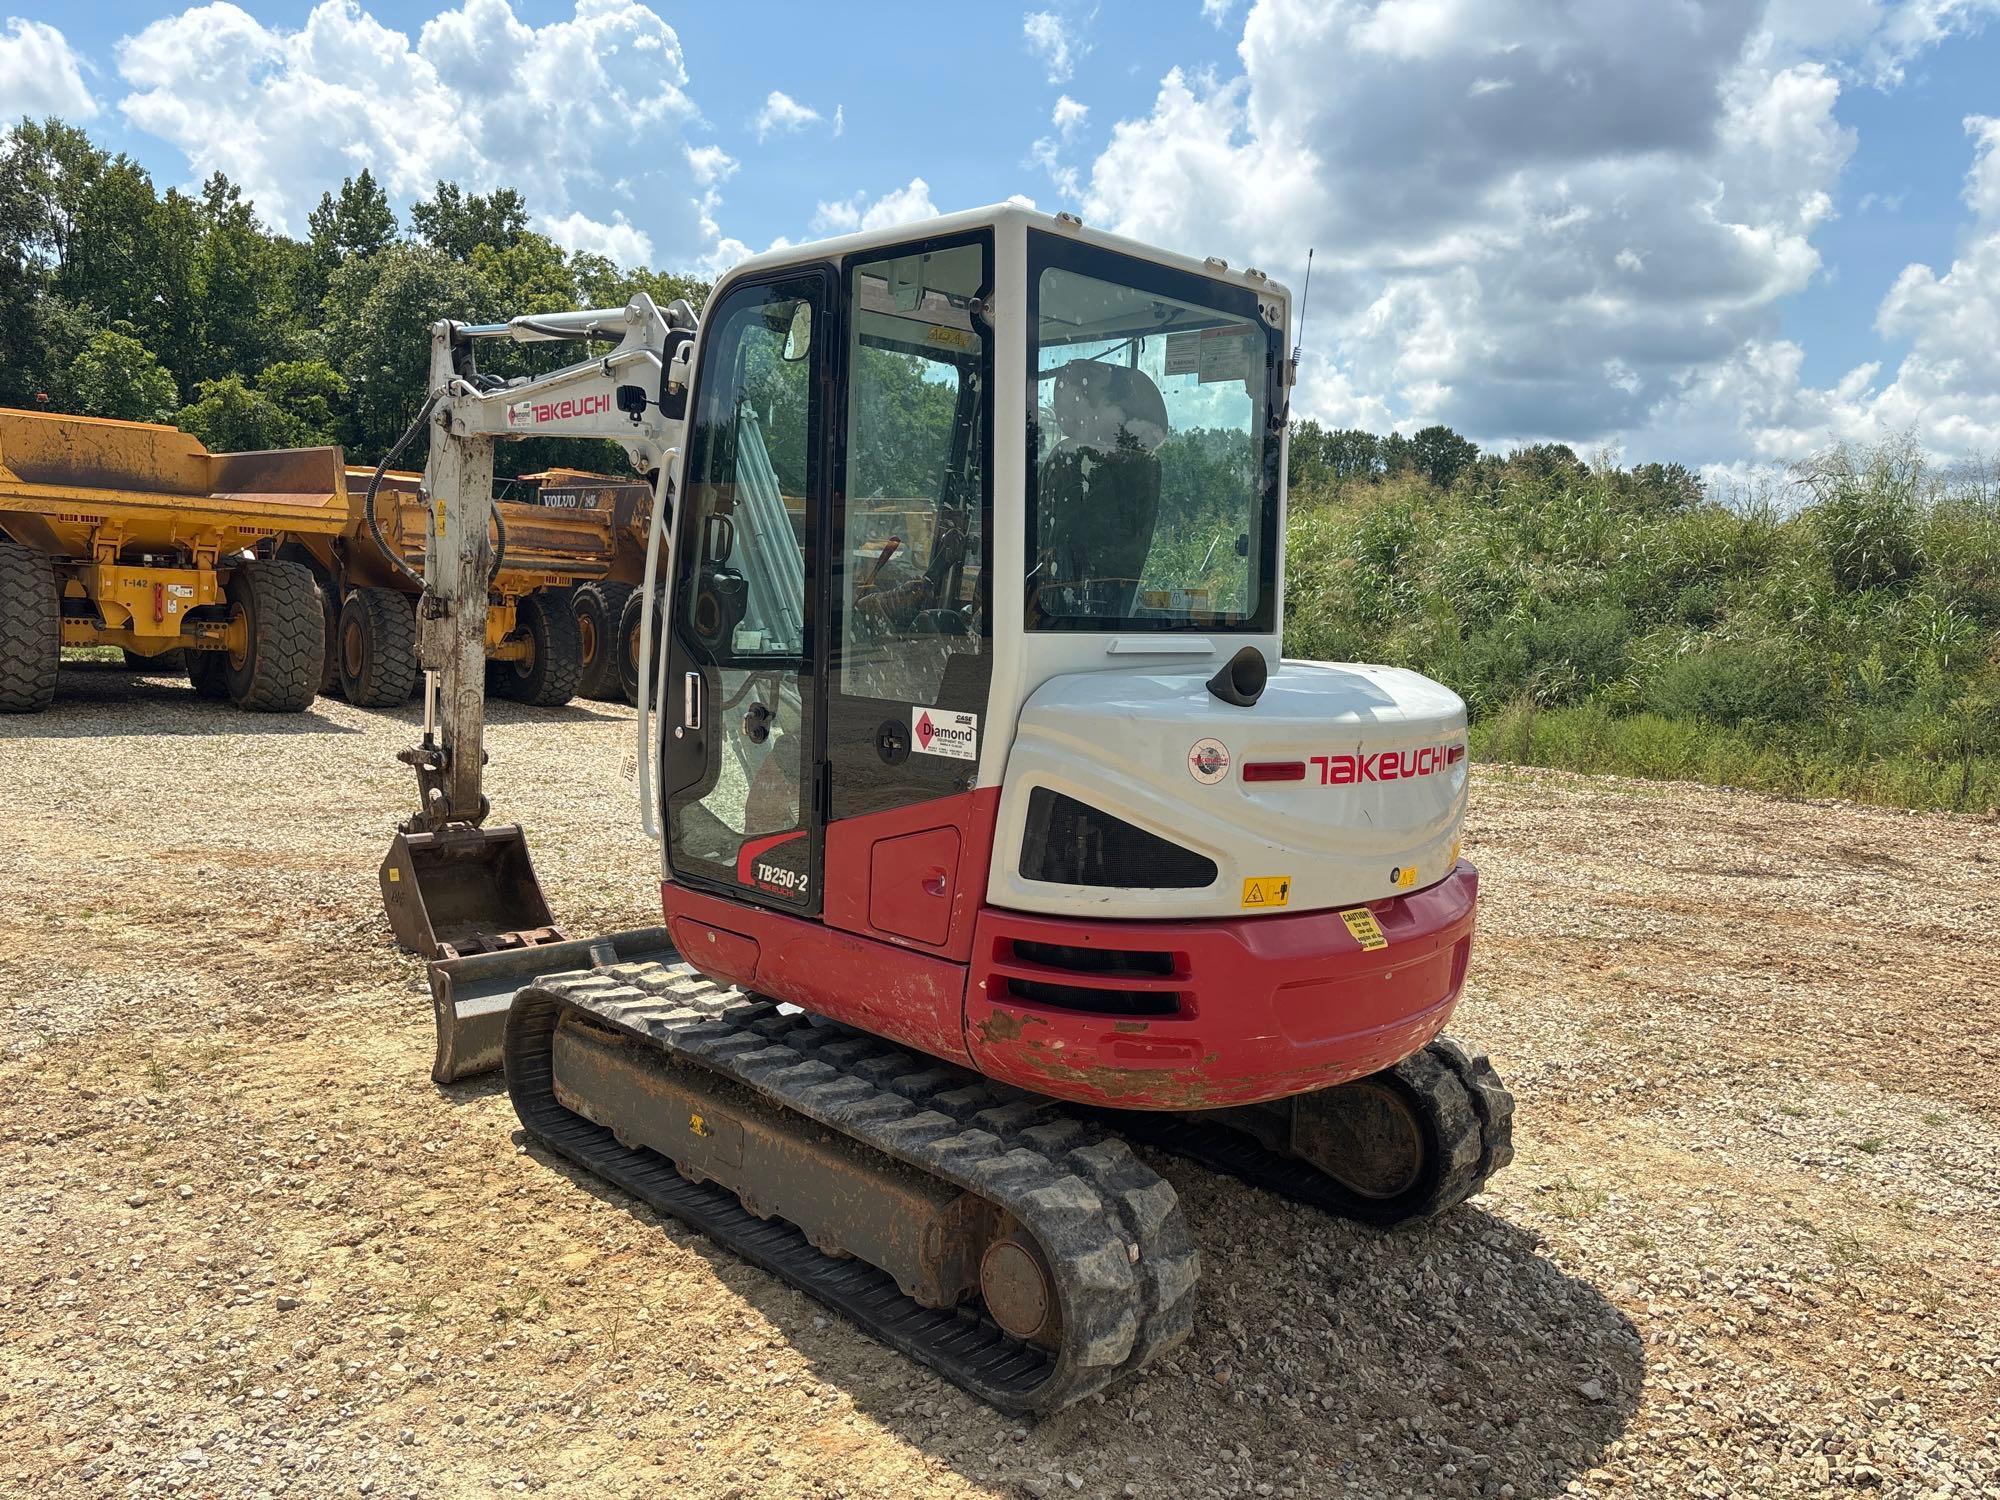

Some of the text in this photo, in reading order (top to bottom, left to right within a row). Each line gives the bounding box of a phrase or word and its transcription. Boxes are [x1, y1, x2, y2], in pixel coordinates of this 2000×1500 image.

[531, 394, 610, 423] TAKEUCHI
[543, 494, 576, 508] VOLVO
[123, 579, 148, 588] T-142
[923, 722, 972, 742] Diamond
[1310, 745, 1447, 785] TAKEUCHI
[758, 863, 809, 892] TB250-2
[1343, 911, 1370, 922] CAUTION!
